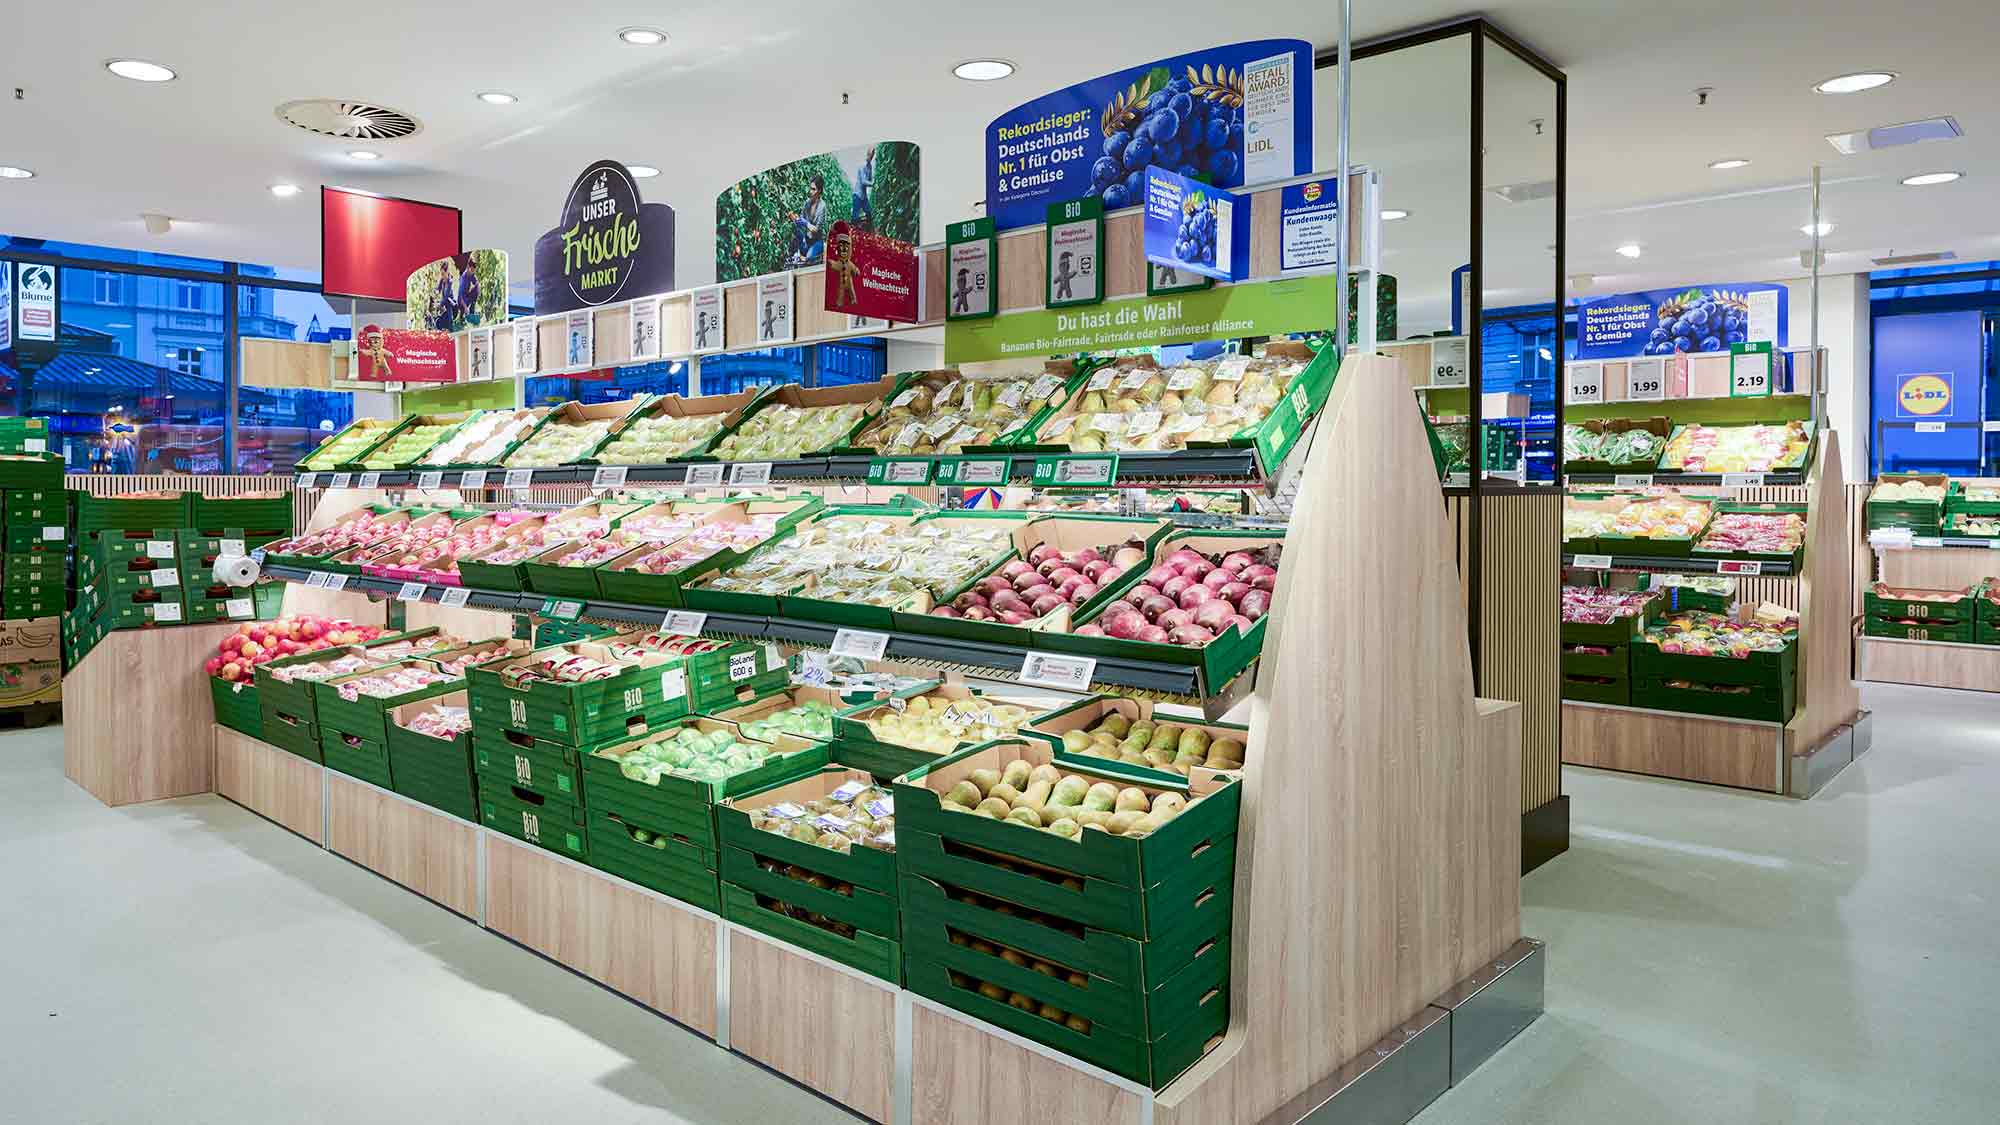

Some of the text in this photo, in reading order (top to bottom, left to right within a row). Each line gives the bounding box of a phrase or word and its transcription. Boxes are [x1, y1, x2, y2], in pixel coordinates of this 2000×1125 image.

[1248, 66, 1284, 82] RETAIL
[1248, 77, 1285, 93] AWARD
[998, 109, 1091, 142] Rekordsieger:
[998, 126, 1090, 159] Deutschlands
[1248, 138, 1274, 153] LIDL
[998, 145, 1084, 176] Nr. 1 für Obst
[998, 169, 1064, 193] & Gemüse
[583, 199, 616, 221] UNSER
[561, 212, 641, 276] Frische
[581, 267, 618, 290] MARKT
[872, 266, 901, 281] Magische
[863, 278, 910, 296] Weihnachtszeit
[22, 291, 52, 301] Blume
[1057, 300, 1182, 331] Du hast die Wahl
[1586, 304, 1651, 316] Rekordsieger:
[1587, 312, 1649, 324] Deutschlands
[1607, 323, 1621, 331] für
[1623, 320, 1646, 329] Obst
[1001, 341, 1034, 353] Bananen
[1095, 330, 1134, 343] Fairtrade
[1136, 327, 1158, 340] oder
[1160, 322, 1210, 337] Rainforest
[1213, 318, 1254, 332] Alliance
[1595, 331, 1632, 341] Gemüse
[406, 349, 437, 358] Magische
[1633, 381, 1658, 392] 1.99
[1737, 376, 1764, 387] 2.19
[1574, 385, 1597, 395] 1.99
[730, 655, 754, 666] Bioland
[733, 667, 746, 677] 600
